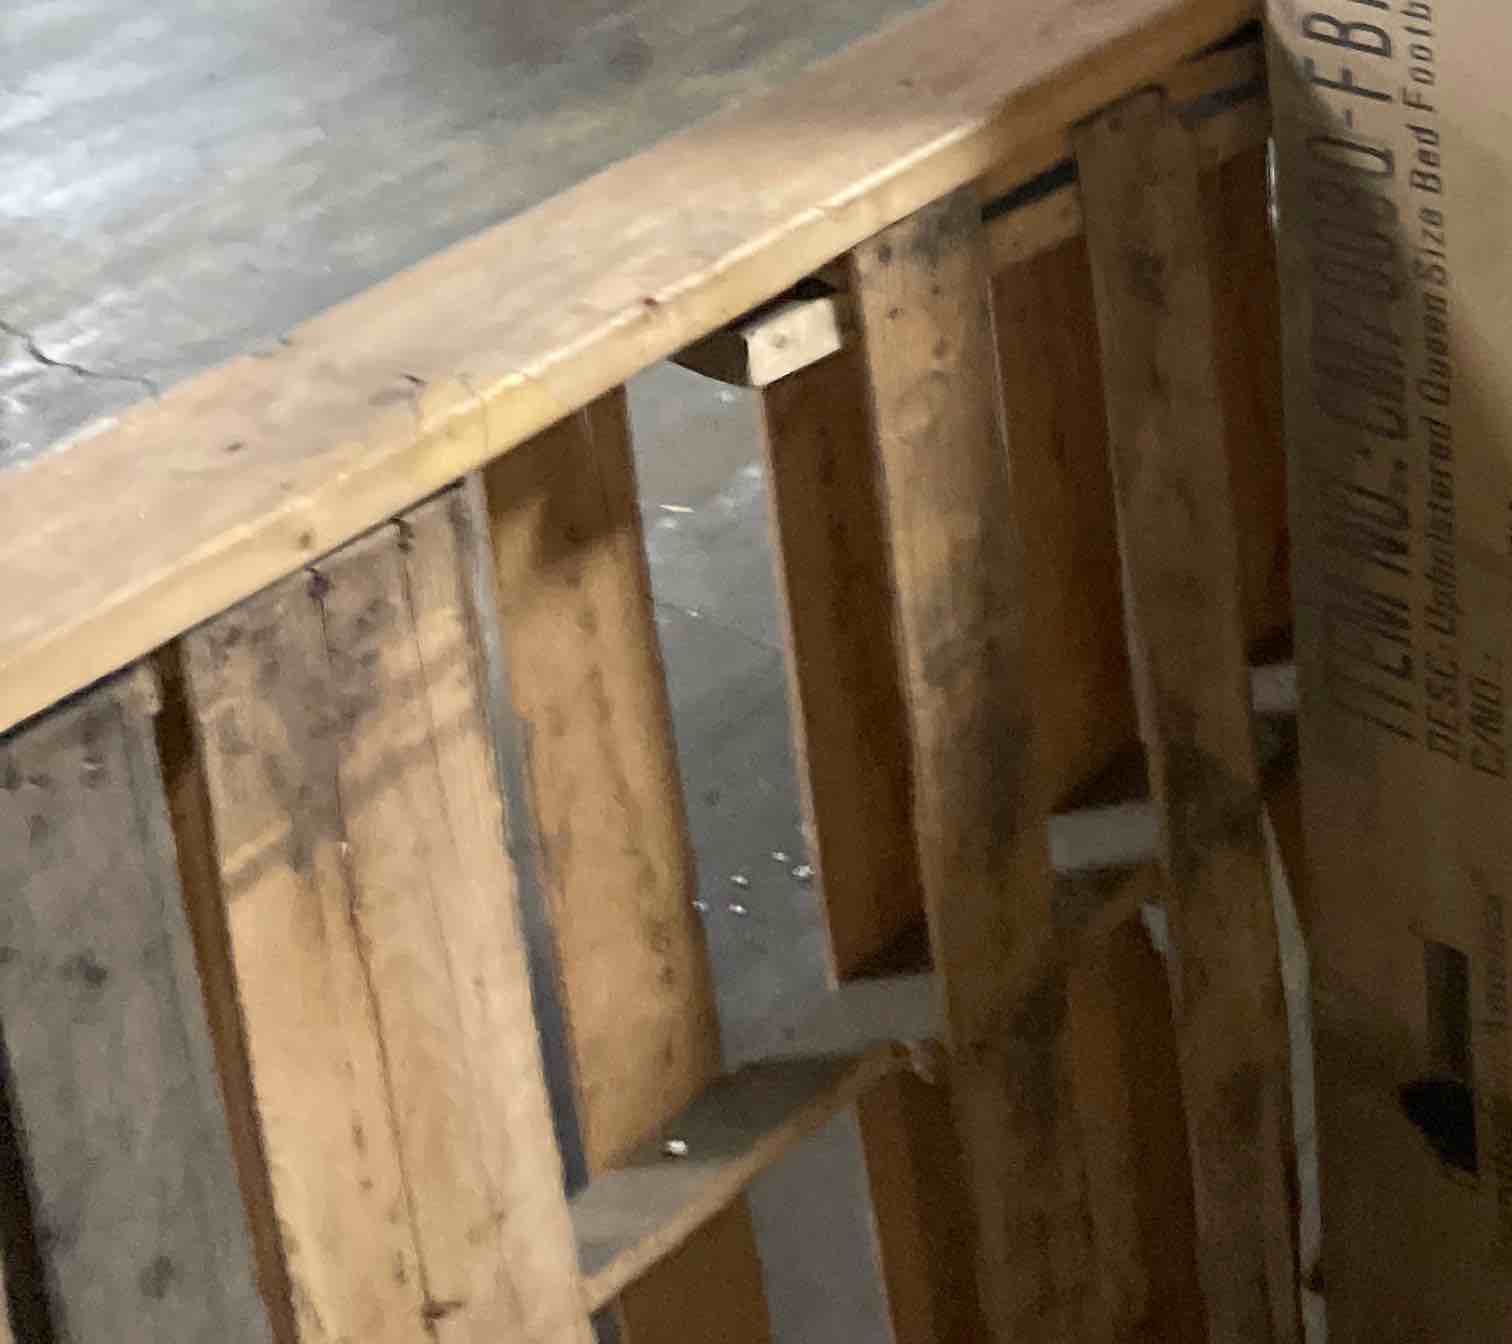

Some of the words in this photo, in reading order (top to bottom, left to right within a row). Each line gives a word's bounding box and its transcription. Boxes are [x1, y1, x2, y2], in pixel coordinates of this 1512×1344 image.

[1403, 127, 1443, 195] Bed
[1411, 207, 1450, 288] Size
[1415, 295, 1454, 408] Queen
[1418, 418, 1464, 638] Upholstered
